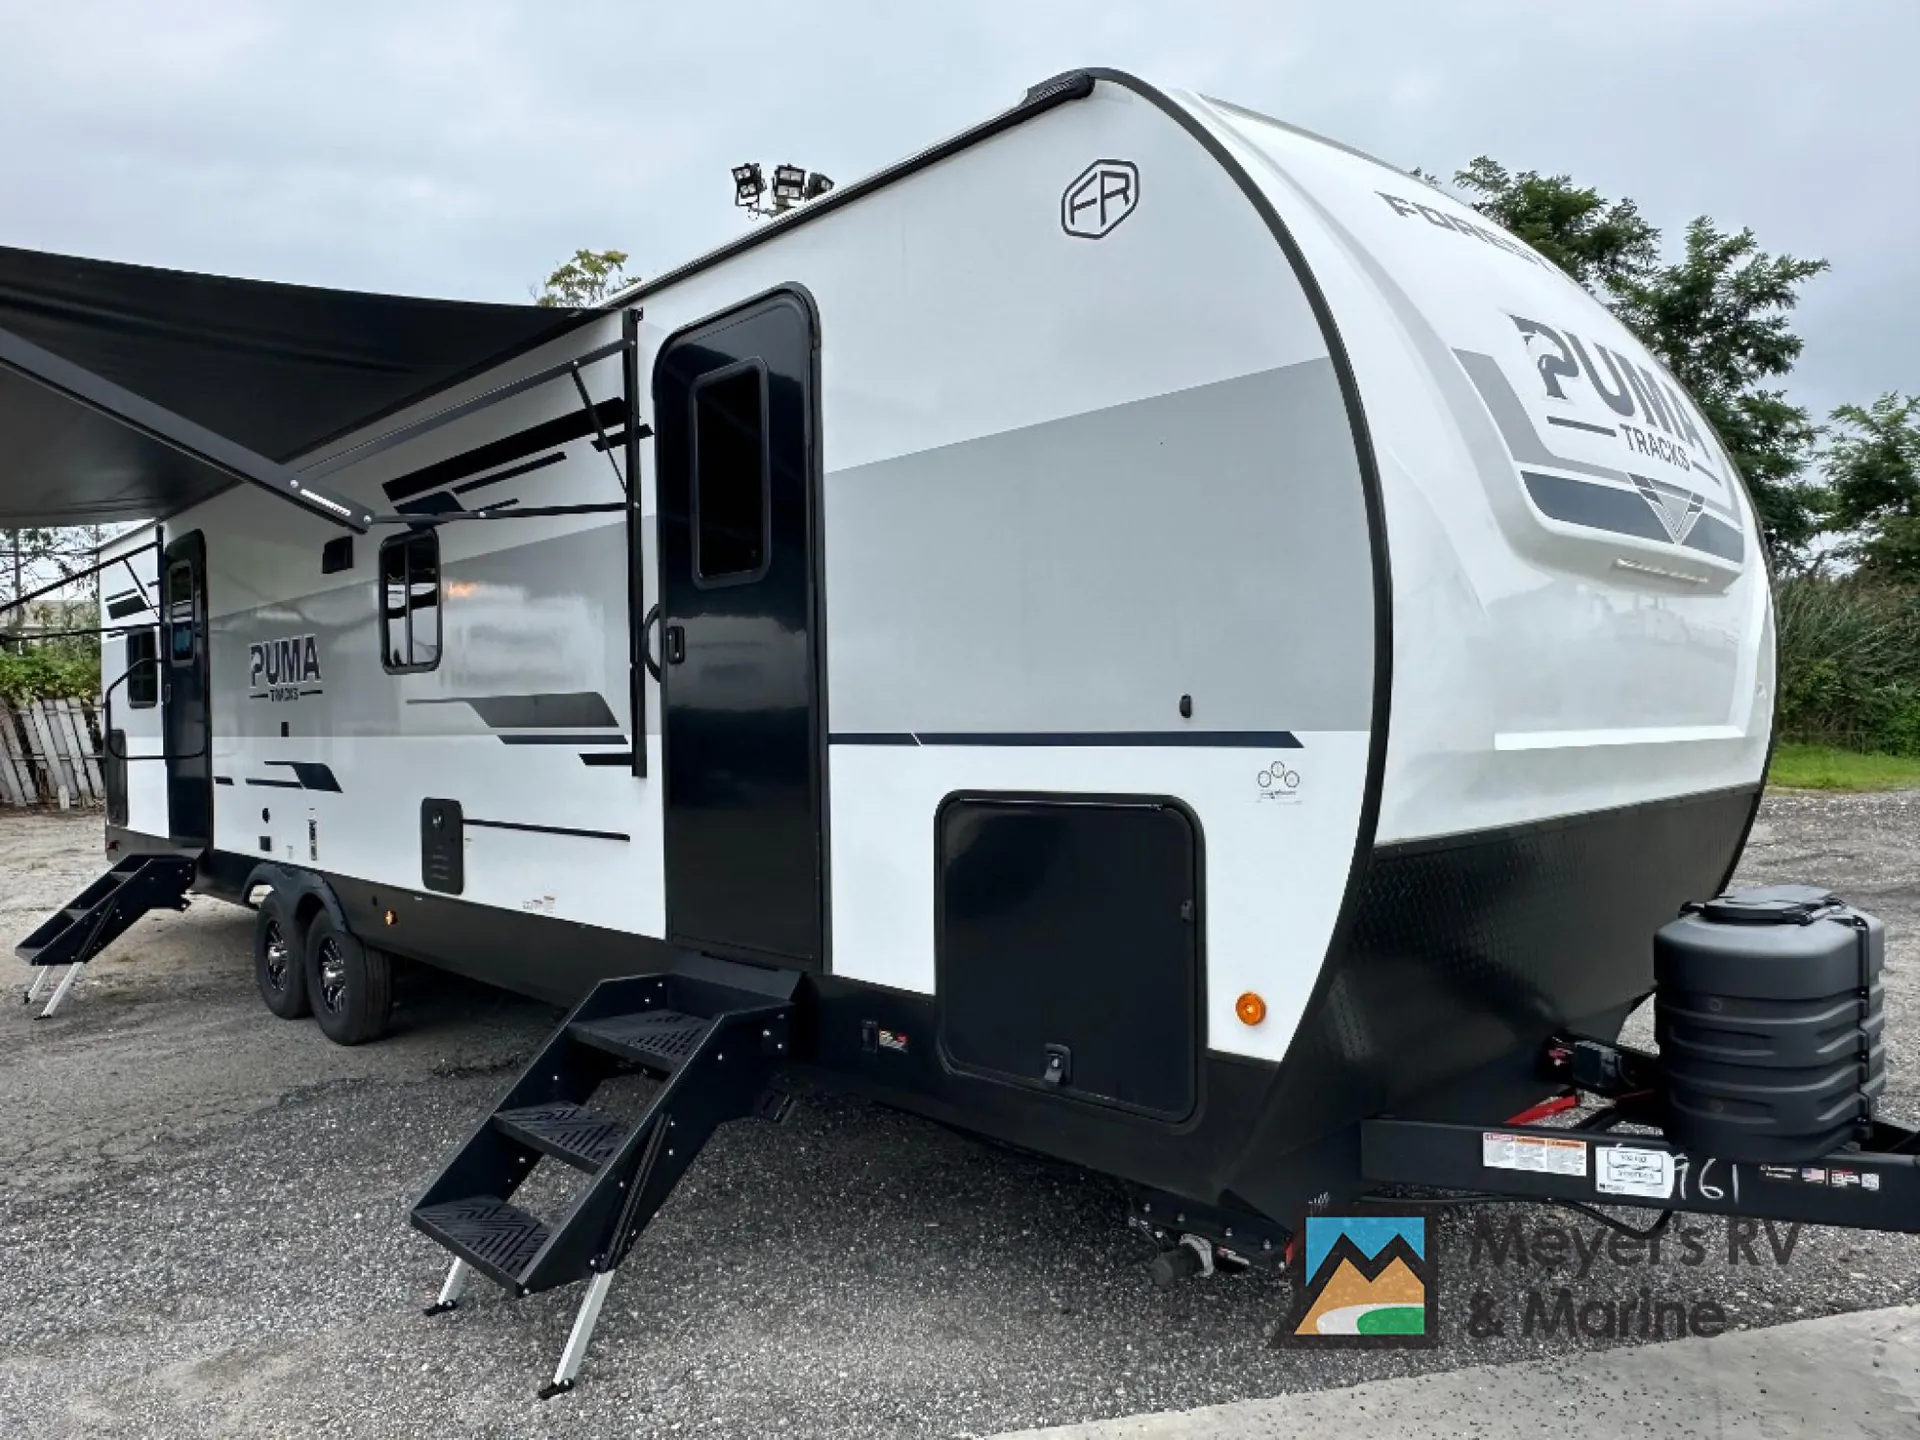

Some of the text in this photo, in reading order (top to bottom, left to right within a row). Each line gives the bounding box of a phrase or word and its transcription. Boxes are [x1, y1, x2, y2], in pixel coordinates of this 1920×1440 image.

[1069, 170, 1131, 228] FR
[1508, 314, 1713, 462] PUMA
[1619, 423, 1691, 472] TRACKS
[247, 633, 322, 689] PUMA
